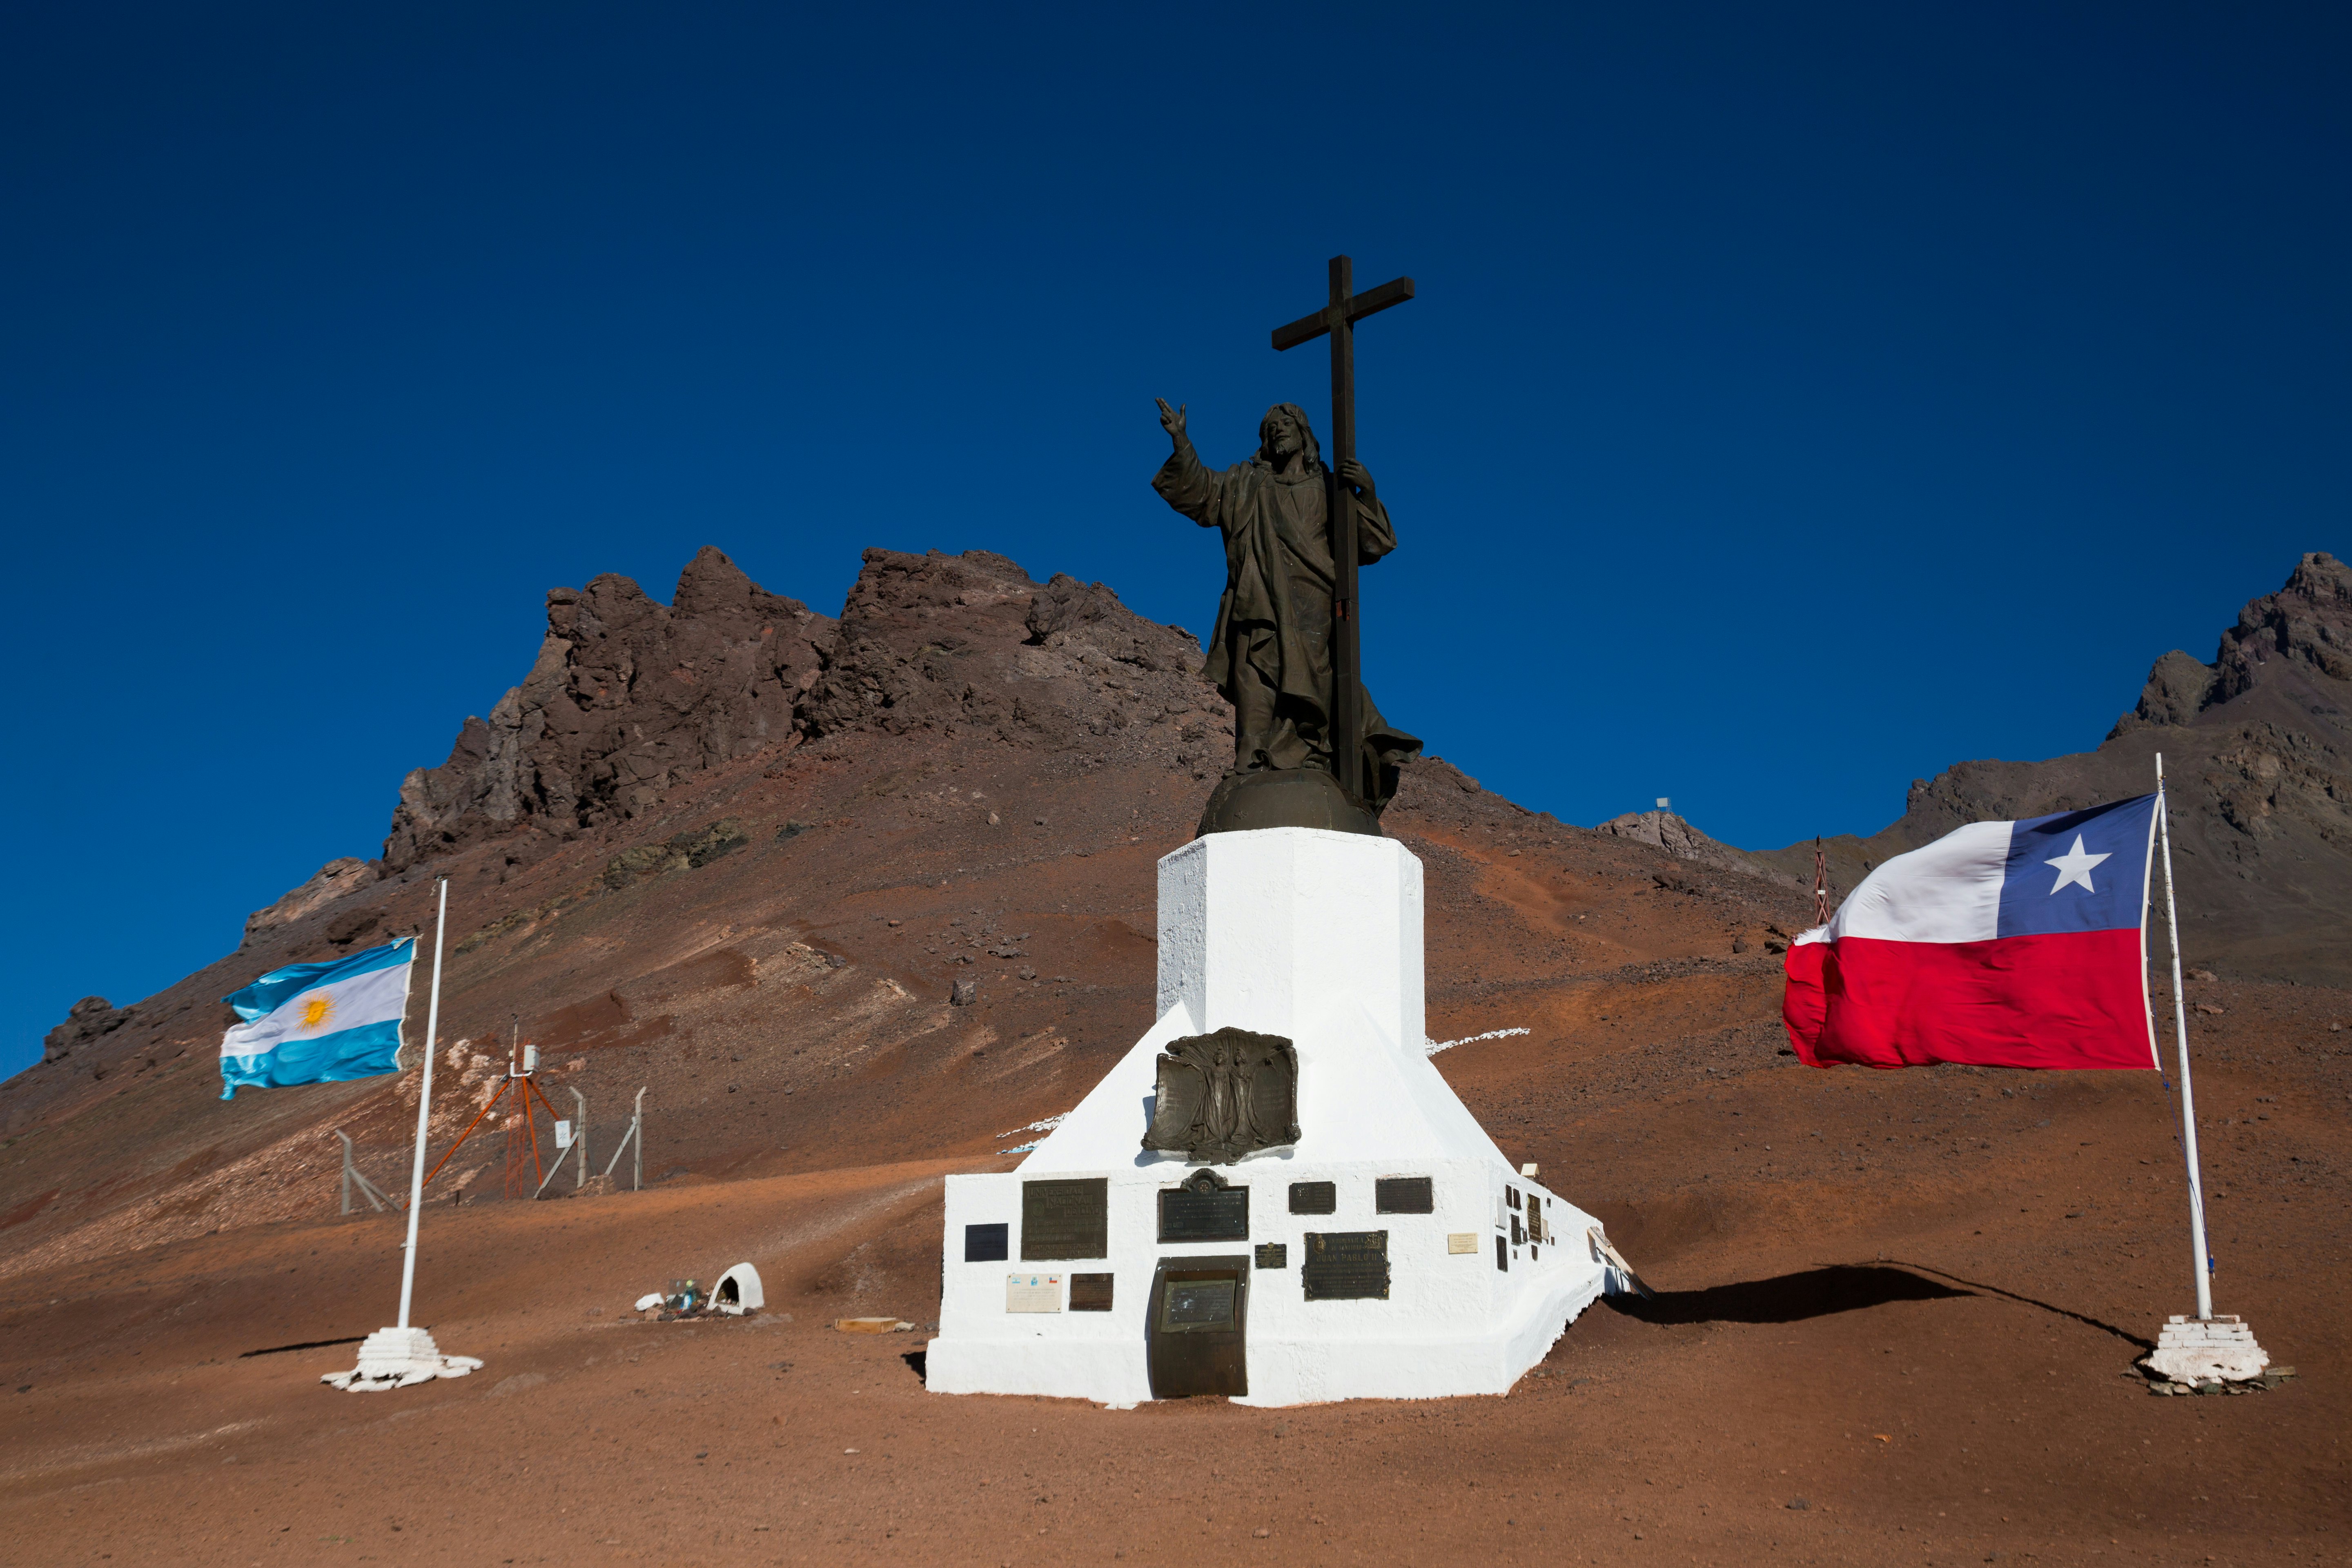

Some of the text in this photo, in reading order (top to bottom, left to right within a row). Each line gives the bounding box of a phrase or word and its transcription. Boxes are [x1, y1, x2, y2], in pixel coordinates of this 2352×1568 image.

[1049, 1196, 1090, 1206] NACIONAL
[1066, 1206, 1100, 1215] DE CUYO
[1342, 1254, 1368, 1262] PABLO
